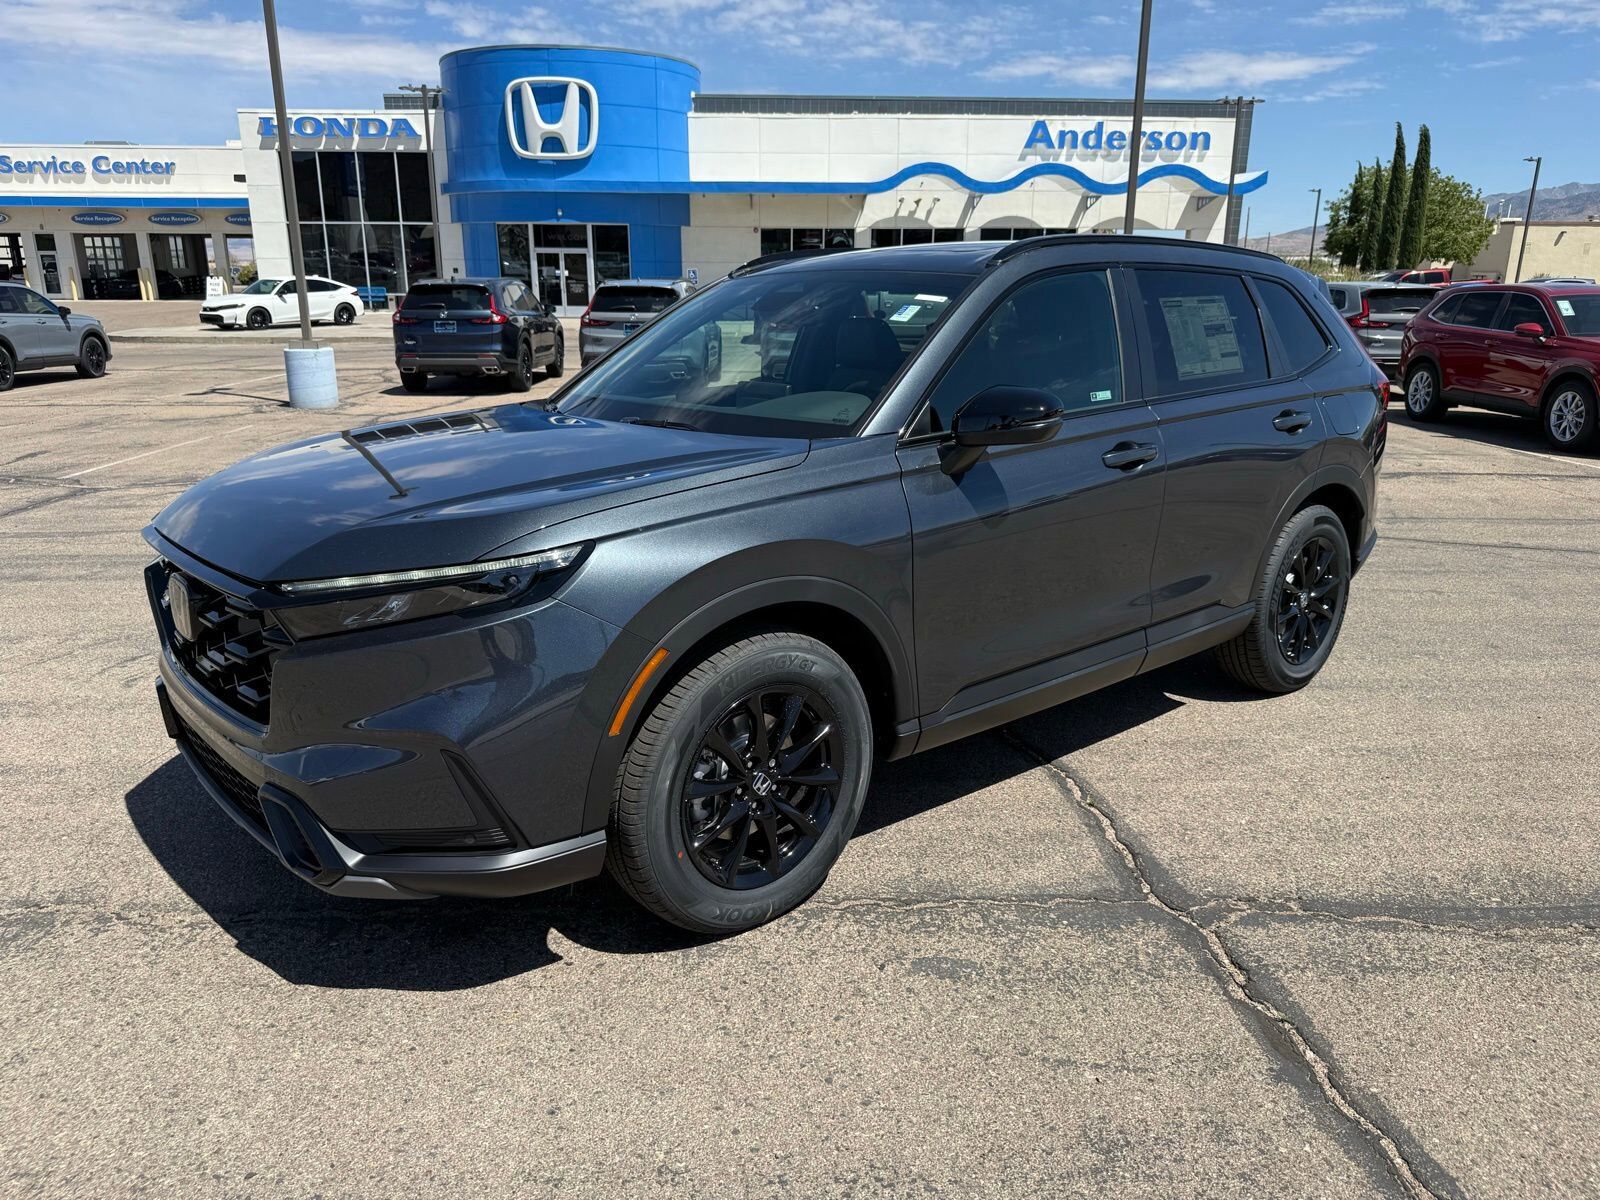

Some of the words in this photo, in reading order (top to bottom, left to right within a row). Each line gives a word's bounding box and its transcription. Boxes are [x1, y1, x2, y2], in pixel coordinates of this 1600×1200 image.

[258, 116, 422, 139] HONDA
[0, 154, 86, 174] Service
[92, 155, 176, 175] Center
